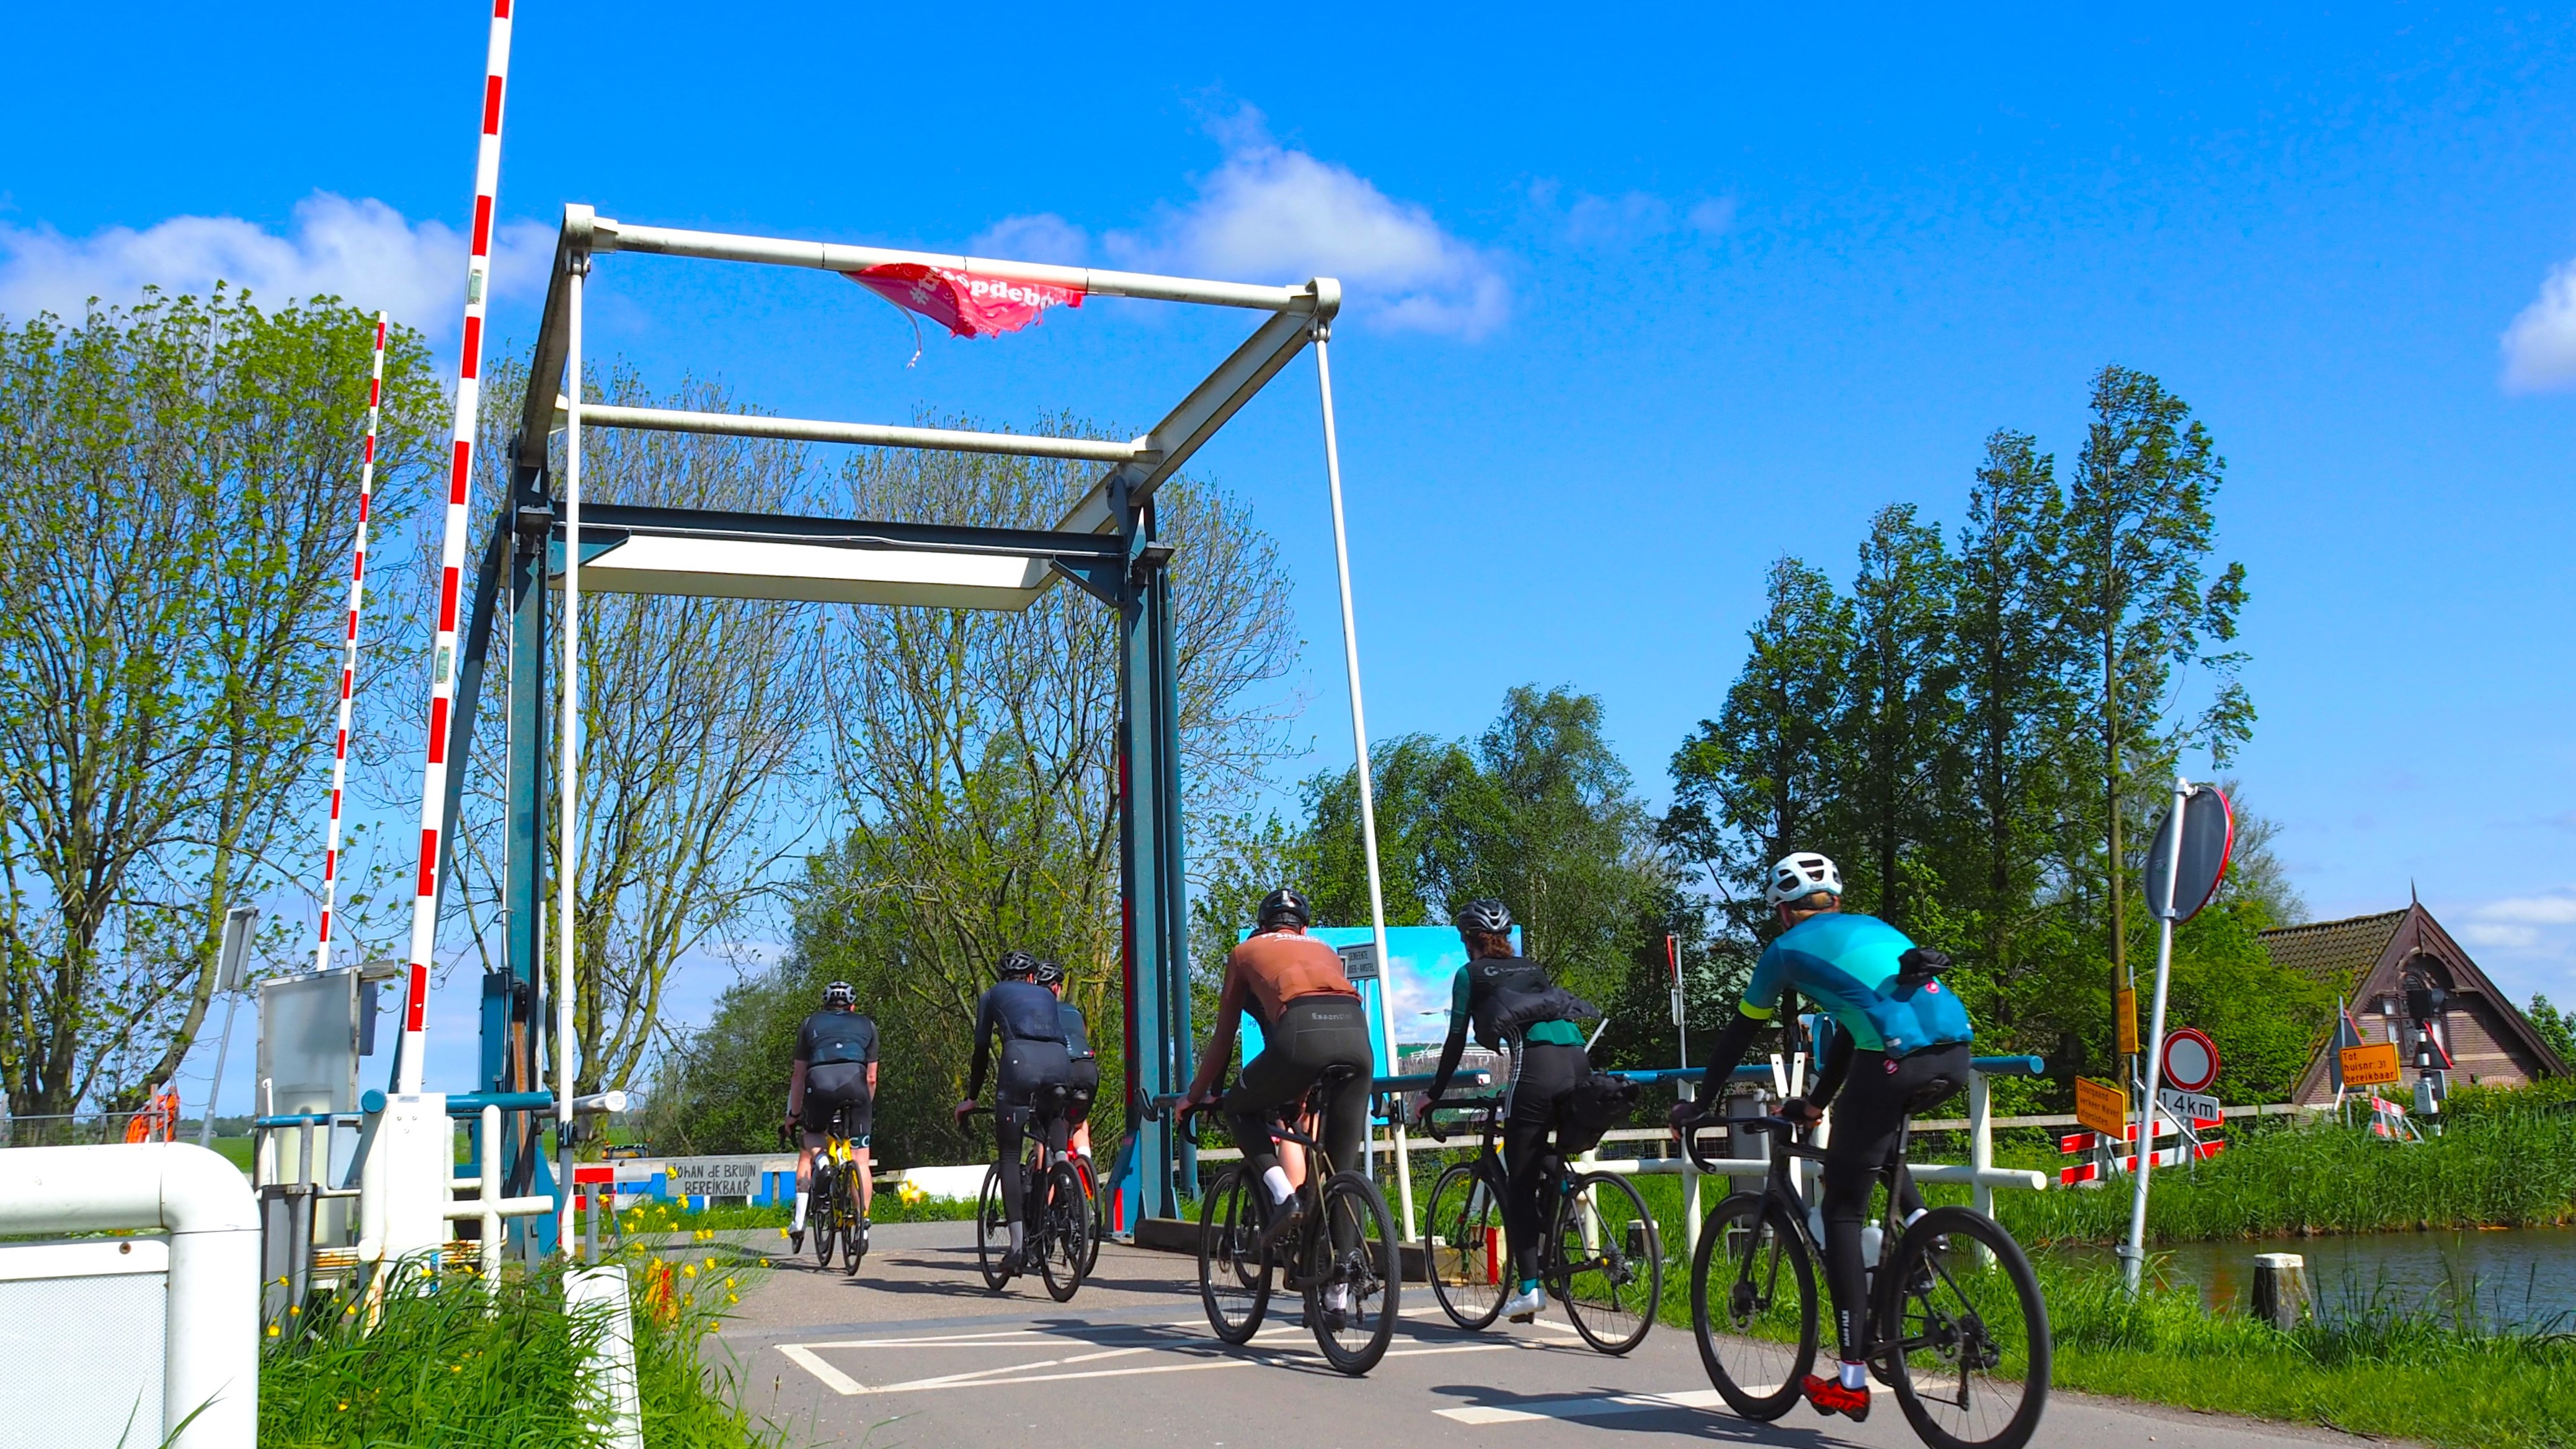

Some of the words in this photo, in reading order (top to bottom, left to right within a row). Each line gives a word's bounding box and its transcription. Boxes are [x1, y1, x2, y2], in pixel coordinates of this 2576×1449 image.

[2343, 1052, 2357, 1061] Tot
[2378, 1060, 2386, 1068] 31
[2345, 1071, 2394, 1083] bereikbaar
[2079, 1082, 2108, 1101] Doorgaand
[2079, 1097, 2100, 1110] verkeer
[2081, 1109, 2109, 1126] afgesloten
